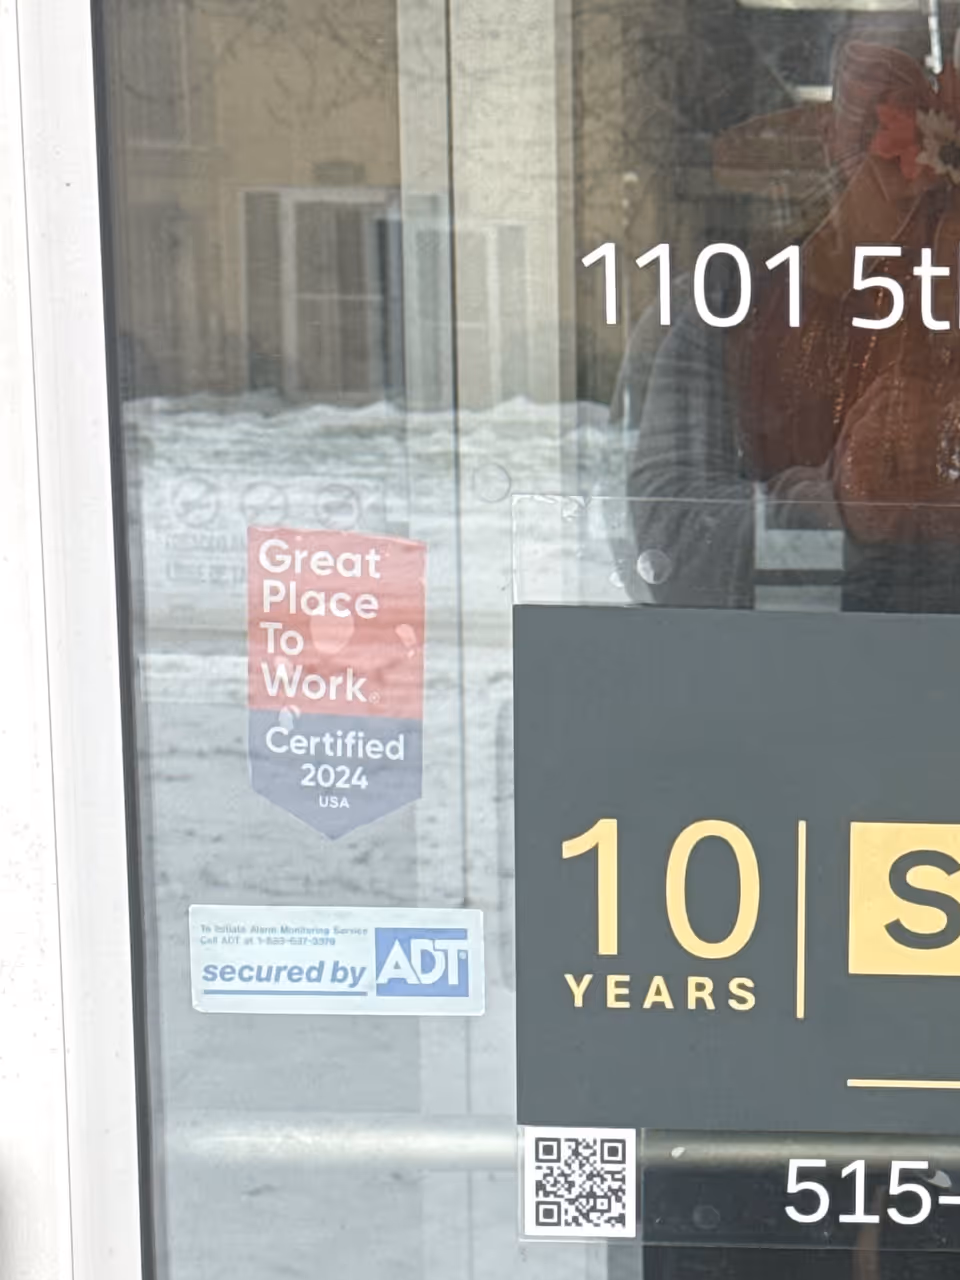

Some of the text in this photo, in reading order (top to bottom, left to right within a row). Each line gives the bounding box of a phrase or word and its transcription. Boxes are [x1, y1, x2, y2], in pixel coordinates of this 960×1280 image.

[581, 241, 801, 328] 1101
[259, 538, 381, 578] Great
[262, 578, 379, 619] Place
[259, 621, 304, 655] To
[265, 726, 405, 760] Certified
[300, 763, 369, 789] 2024
[318, 796, 350, 808] USA
[562, 818, 761, 959] 10
[250, 926, 277, 935] Alarm
[280, 926, 330, 936] Monitoring
[202, 960, 367, 988] secured by
[376, 938, 468, 985] ADT
[563, 973, 758, 1012] YEARS
